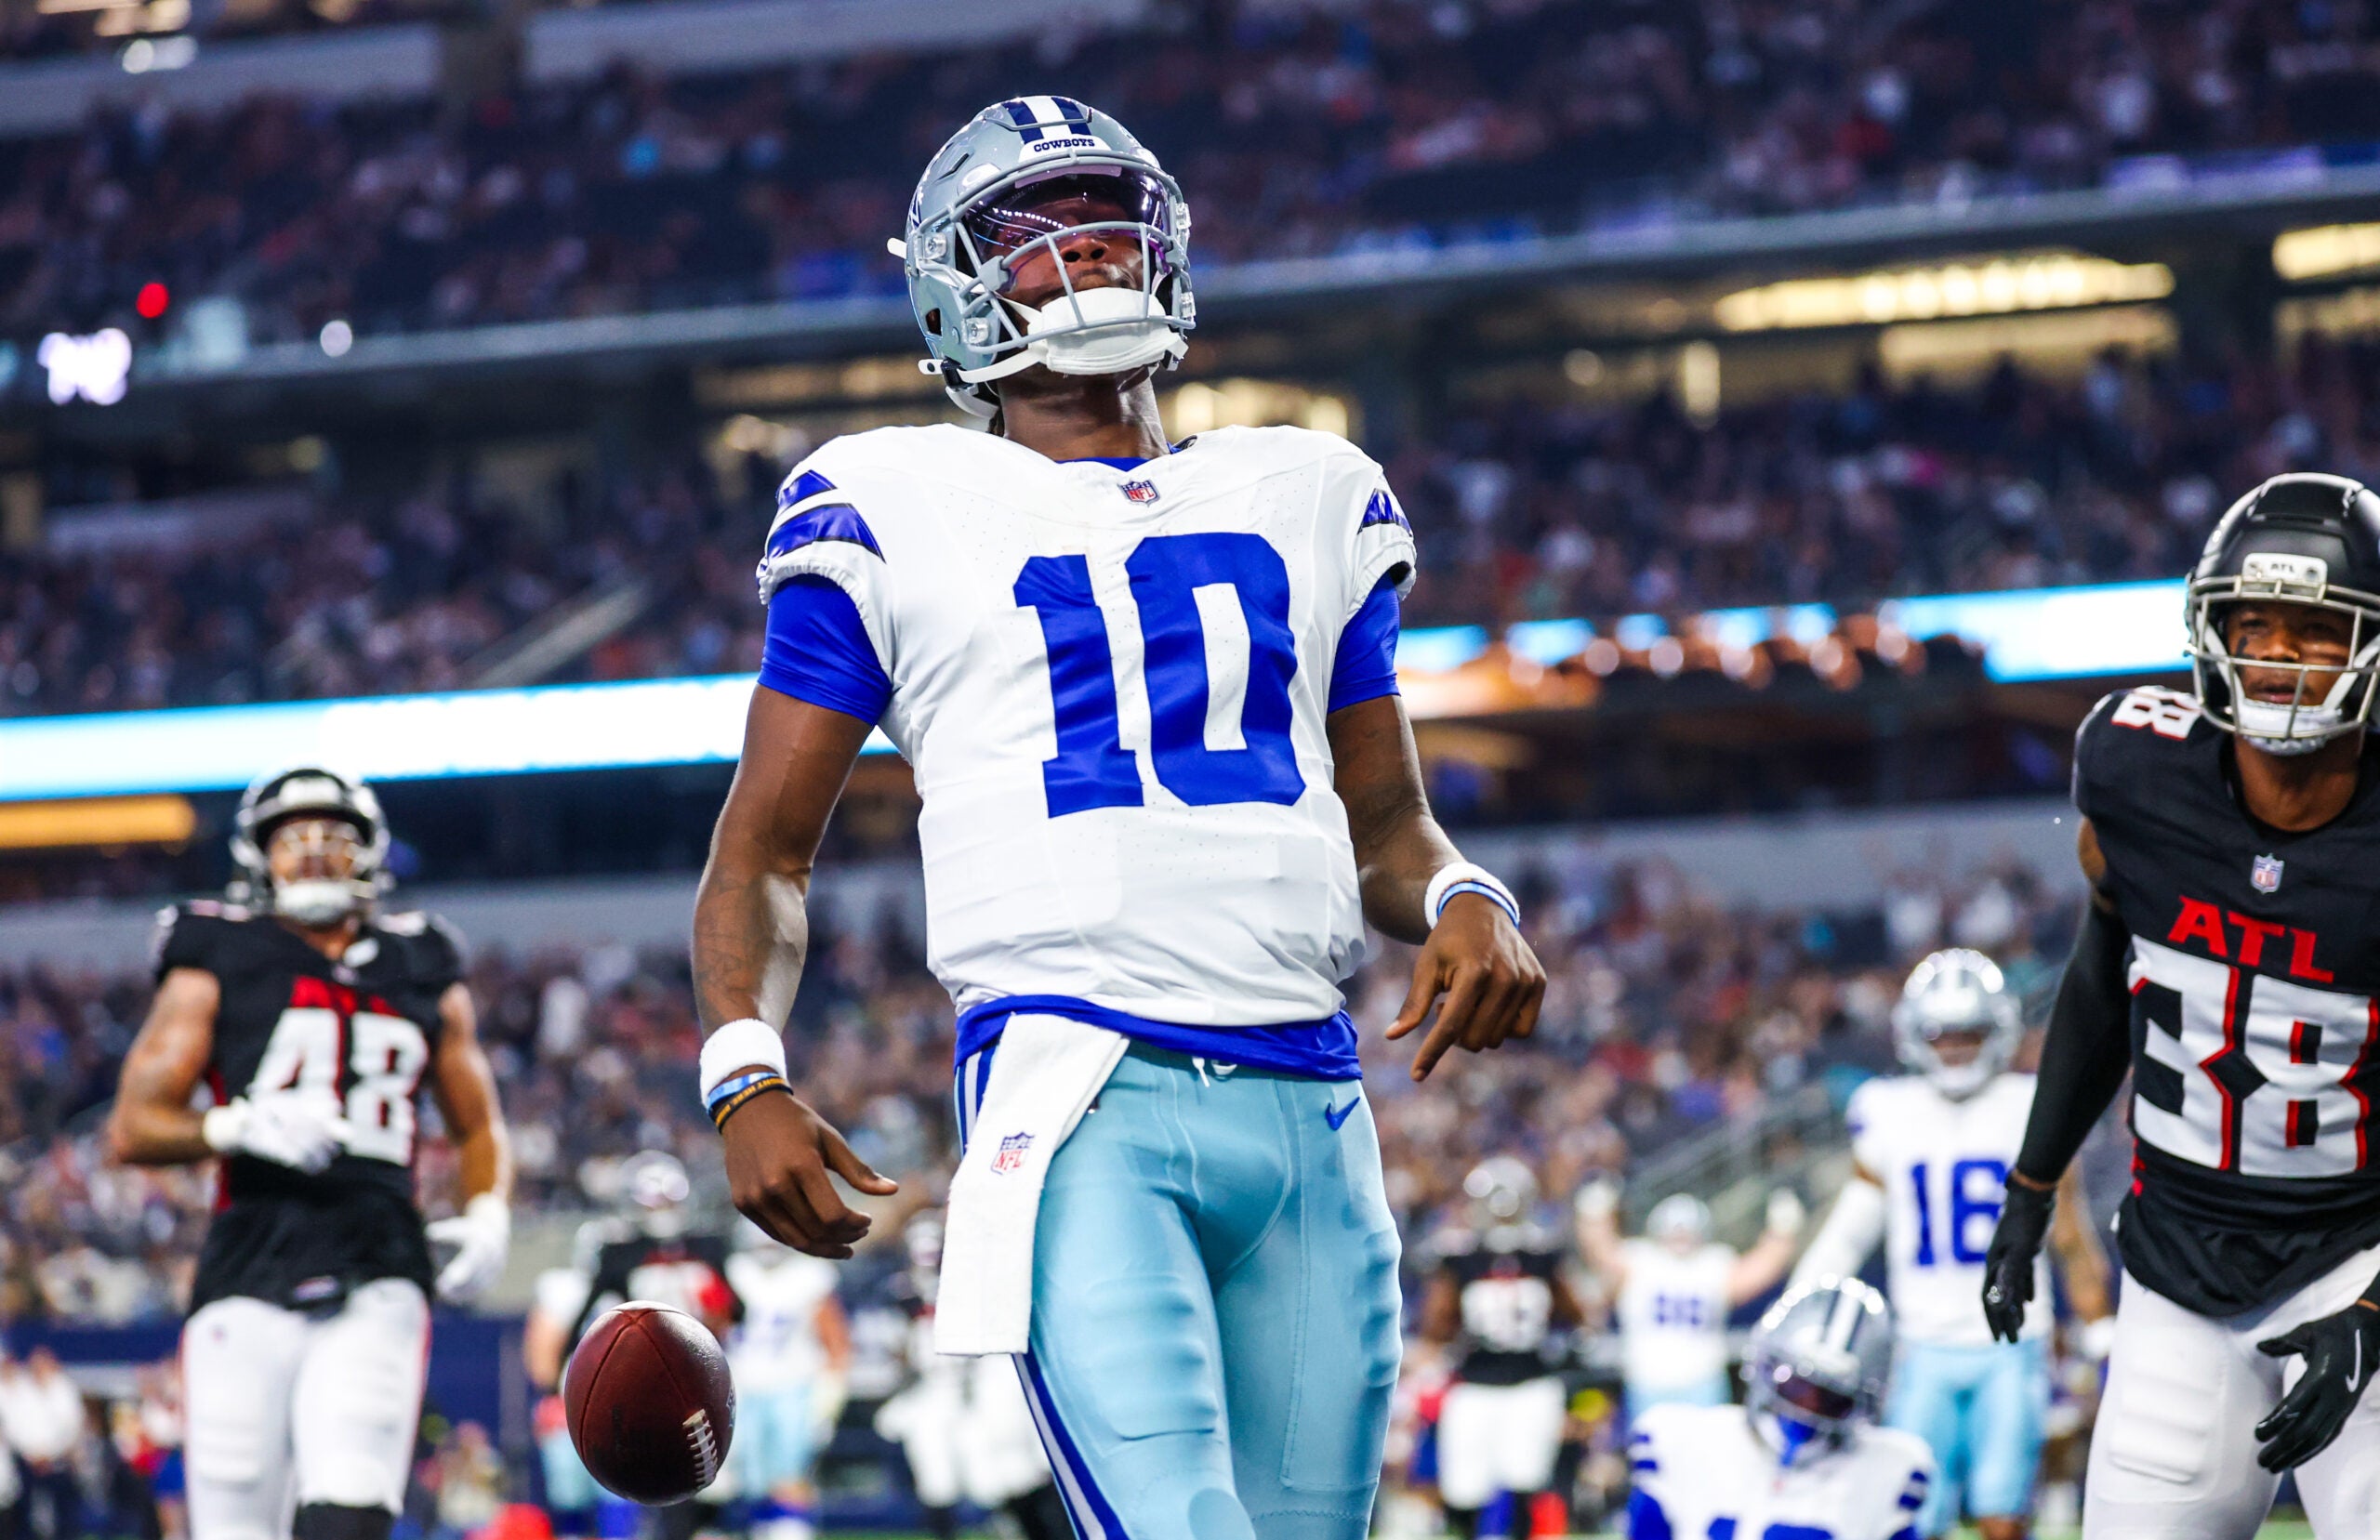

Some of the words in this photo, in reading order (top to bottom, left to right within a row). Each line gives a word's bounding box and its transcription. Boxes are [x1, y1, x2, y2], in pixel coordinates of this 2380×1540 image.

[1034, 138, 1095, 152] COWBOYS
[1012, 532, 1307, 819] 10
[2167, 895, 2334, 984] ATL
[245, 1007, 430, 1166] 48
[2128, 933, 2379, 1178] 38
[1911, 1159, 2007, 1267] 16
